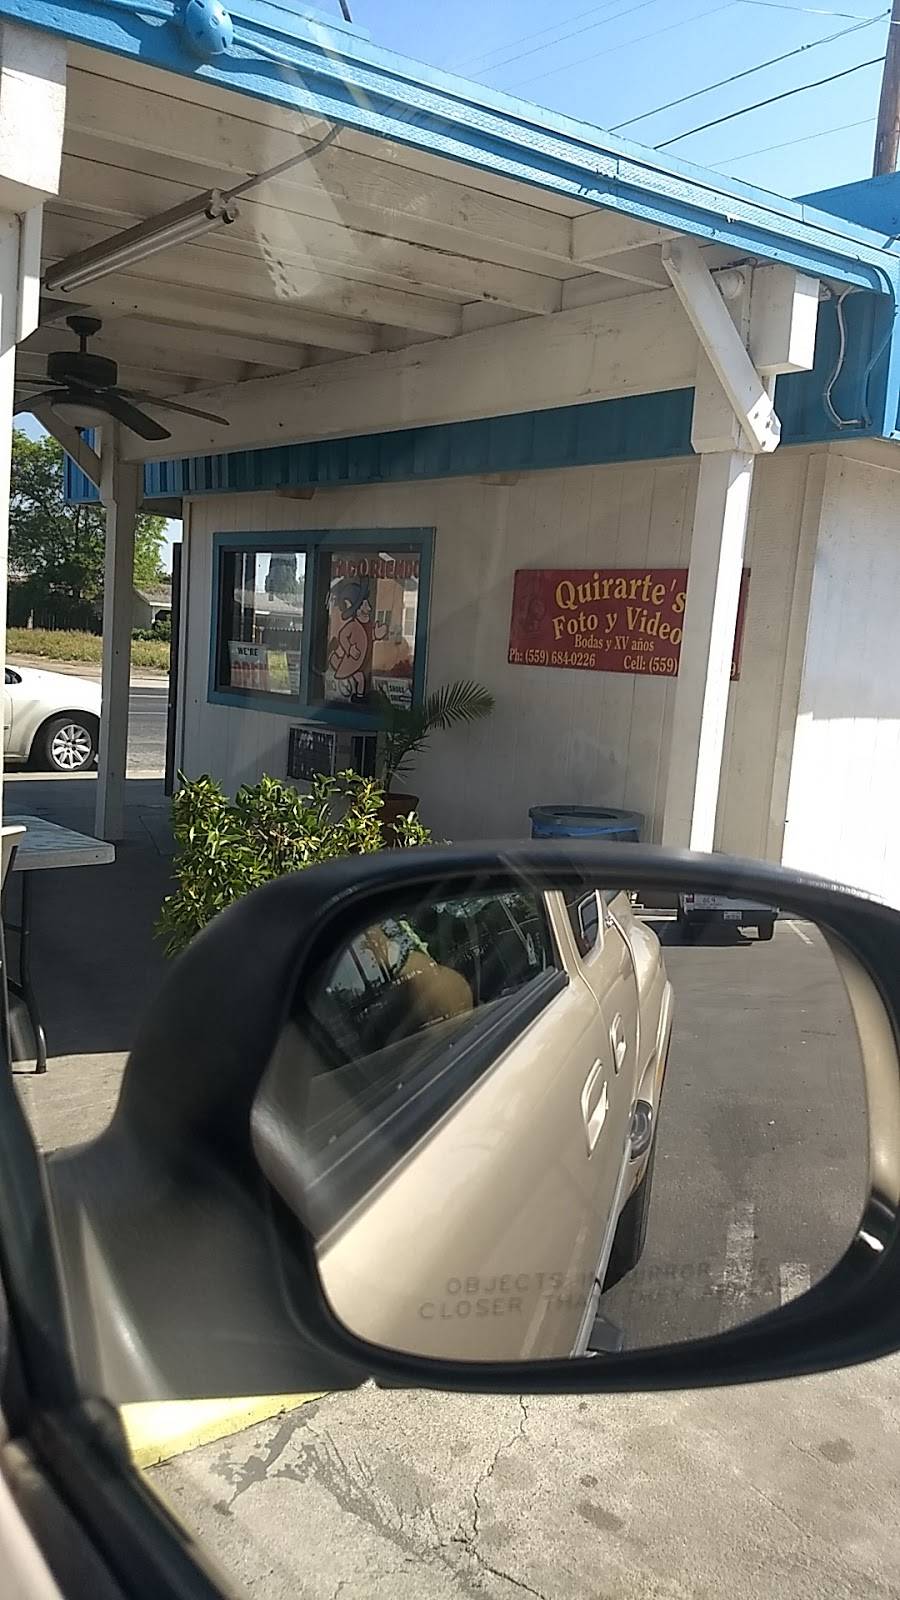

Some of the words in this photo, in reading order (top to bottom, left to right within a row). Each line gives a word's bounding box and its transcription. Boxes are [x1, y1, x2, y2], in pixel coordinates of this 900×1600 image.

[556, 572, 687, 613] Quirarte's
[552, 612, 598, 639] Foto
[605, 613, 617, 633] y
[626, 606, 682, 645] Video
[575, 634, 603, 649] Bodas
[605, 640, 611, 651] y
[614, 636, 629, 650] XV
[631, 638, 655, 651] años
[509, 648, 523, 662] Ph:
[525, 649, 549, 665] (559)
[551, 651, 596, 667] 684-0226
[624, 655, 646, 670] Cell:
[649, 657, 678, 676] (559)
[446, 1271, 562, 1296] OBJECTS
[418, 1297, 524, 1321] CLOSER
